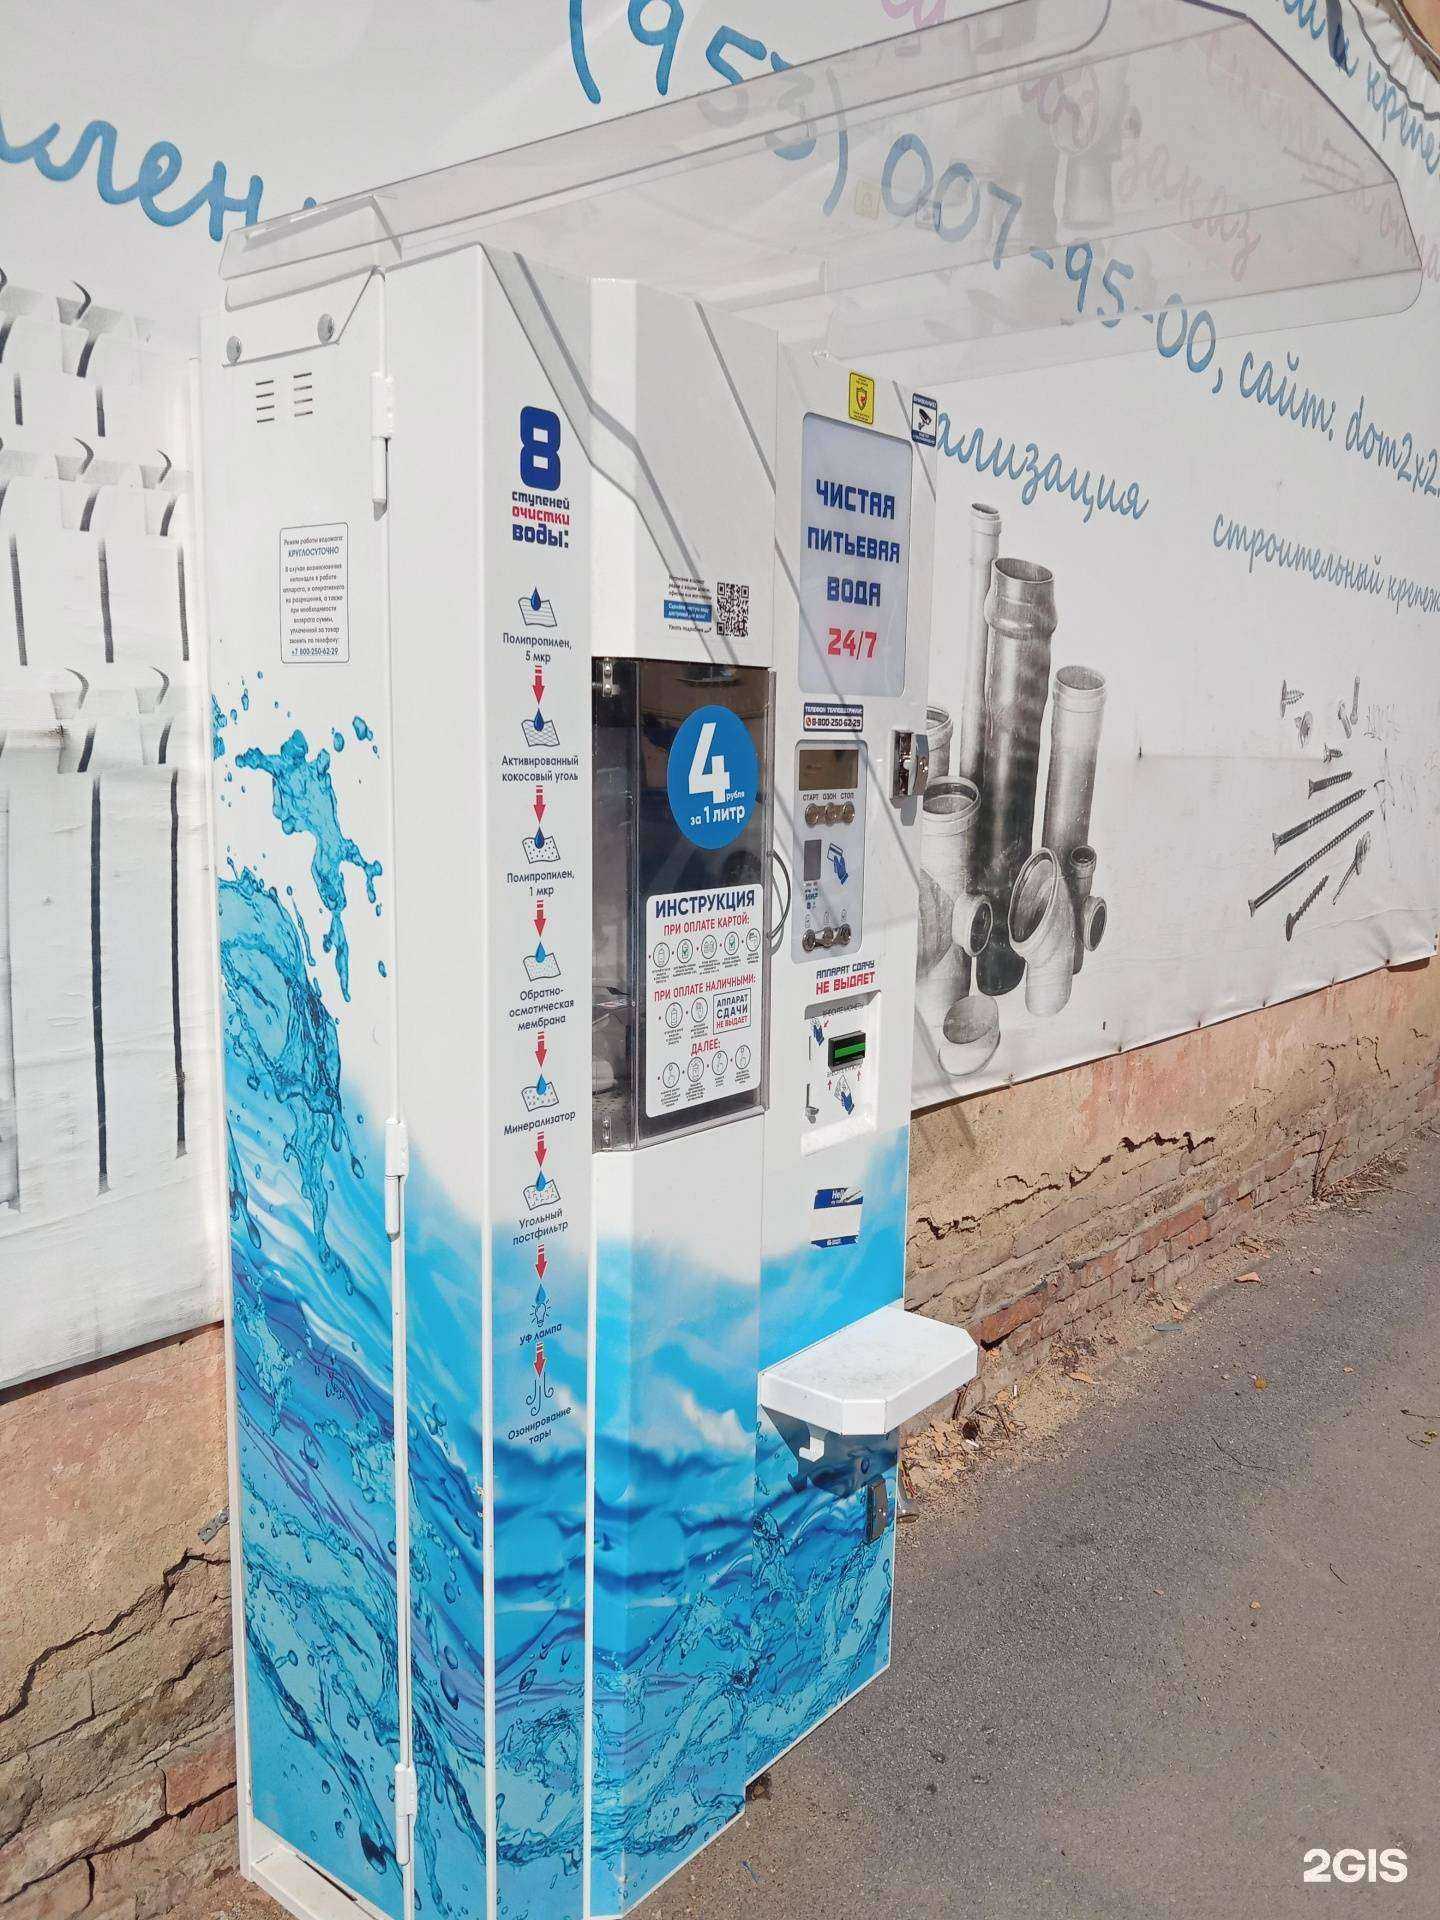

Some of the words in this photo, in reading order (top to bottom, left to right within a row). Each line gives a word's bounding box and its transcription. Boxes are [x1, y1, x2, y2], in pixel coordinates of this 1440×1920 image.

[1368, 60, 1440, 176] крепе
[1239, 350, 1337, 442] сайт:
[1345, 394, 1440, 498] dom2x2
[520, 405, 562, 492] 8
[936, 412, 1149, 523] ализация
[512, 490, 570, 510] ступеней
[816, 478, 895, 520] ЧИСТАЯ
[512, 505, 570, 525] очистки
[512, 524, 570, 549] воды:
[807, 526, 901, 564] ПИТЬЕВАЯ
[1213, 512, 1385, 573] строительный
[288, 546, 340, 558] КРУГЛОСУТОЧНО
[827, 575, 881, 607] ВОДА
[503, 631, 573, 650] Полипропилен,
[827, 627, 878, 660] 24/7
[525, 650, 531, 662] 5
[532, 652, 551, 665] мкр
[501, 754, 579, 768] Активированный
[688, 721, 731, 804] 4
[502, 769, 554, 782] кокосовый
[555, 771, 579, 782] уголь
[803, 793, 819, 801] СТАРТ
[690, 815, 702, 826] за
[703, 805, 710, 824] 1
[712, 804, 746, 824] литр
[507, 869, 575, 885] Полипропилен,
[529, 887, 534, 897] 1
[536, 886, 555, 898] мкр
[655, 889, 755, 919] ИНСТРУКЦИЯ
[664, 922, 681, 936] ПРИ
[683, 917, 715, 933] ОПЛАТЕ
[717, 911, 750, 929] КАРТОЙ:
[816, 964, 851, 979] АППАРАТ
[852, 959, 875, 972] СДАЧУ
[654, 990, 671, 1002] ПРИ
[673, 985, 704, 998] ОПЛАТЕ
[705, 973, 757, 990] НАЛИЧНЫМИ:
[816, 981, 830, 996] НЕ
[833, 971, 876, 991] ВЫДАЕТ
[520, 987, 564, 1002] Обратно-
[716, 993, 748, 1007] АППАРАТ
[509, 998, 575, 1018] осмотическая
[716, 1005, 748, 1019] СДАЧИ
[517, 1014, 566, 1032] мембрана
[716, 1020, 724, 1029] НЕ
[724, 1016, 748, 1028] ВЫДАЕТ
[691, 1038, 721, 1057] ДАЛЕЕ:
[503, 1110, 576, 1136] Минерализатор
[518, 1207, 563, 1230] Угольный
[512, 1220, 569, 1246] постфильтр
[534, 1322, 562, 1339] лампа
[507, 1405, 572, 1441] Озонирование
[528, 1428, 552, 1446] тары
